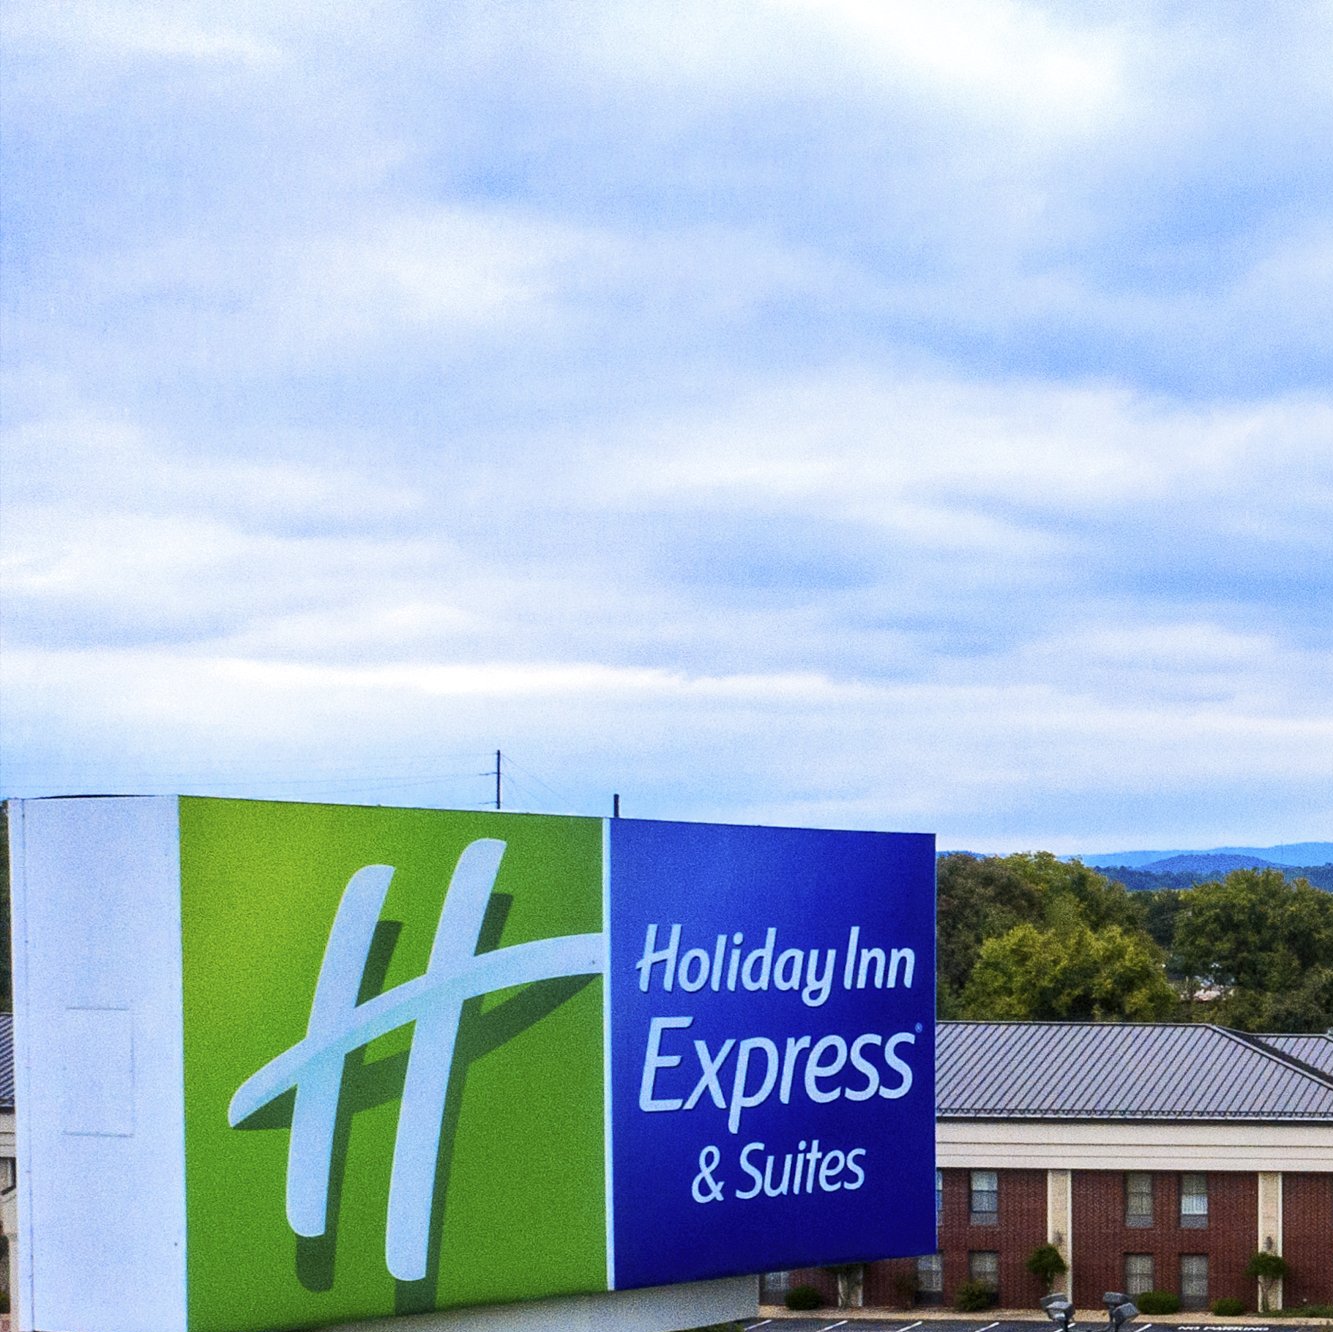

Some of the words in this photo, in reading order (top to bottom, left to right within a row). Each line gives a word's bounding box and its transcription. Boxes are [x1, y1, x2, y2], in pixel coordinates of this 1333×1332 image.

[636, 924, 837, 1007] Holiday
[843, 926, 916, 990] Inn
[639, 1016, 917, 1134] Express
[692, 1145, 725, 1204] &
[736, 1140, 867, 1200] Suites
